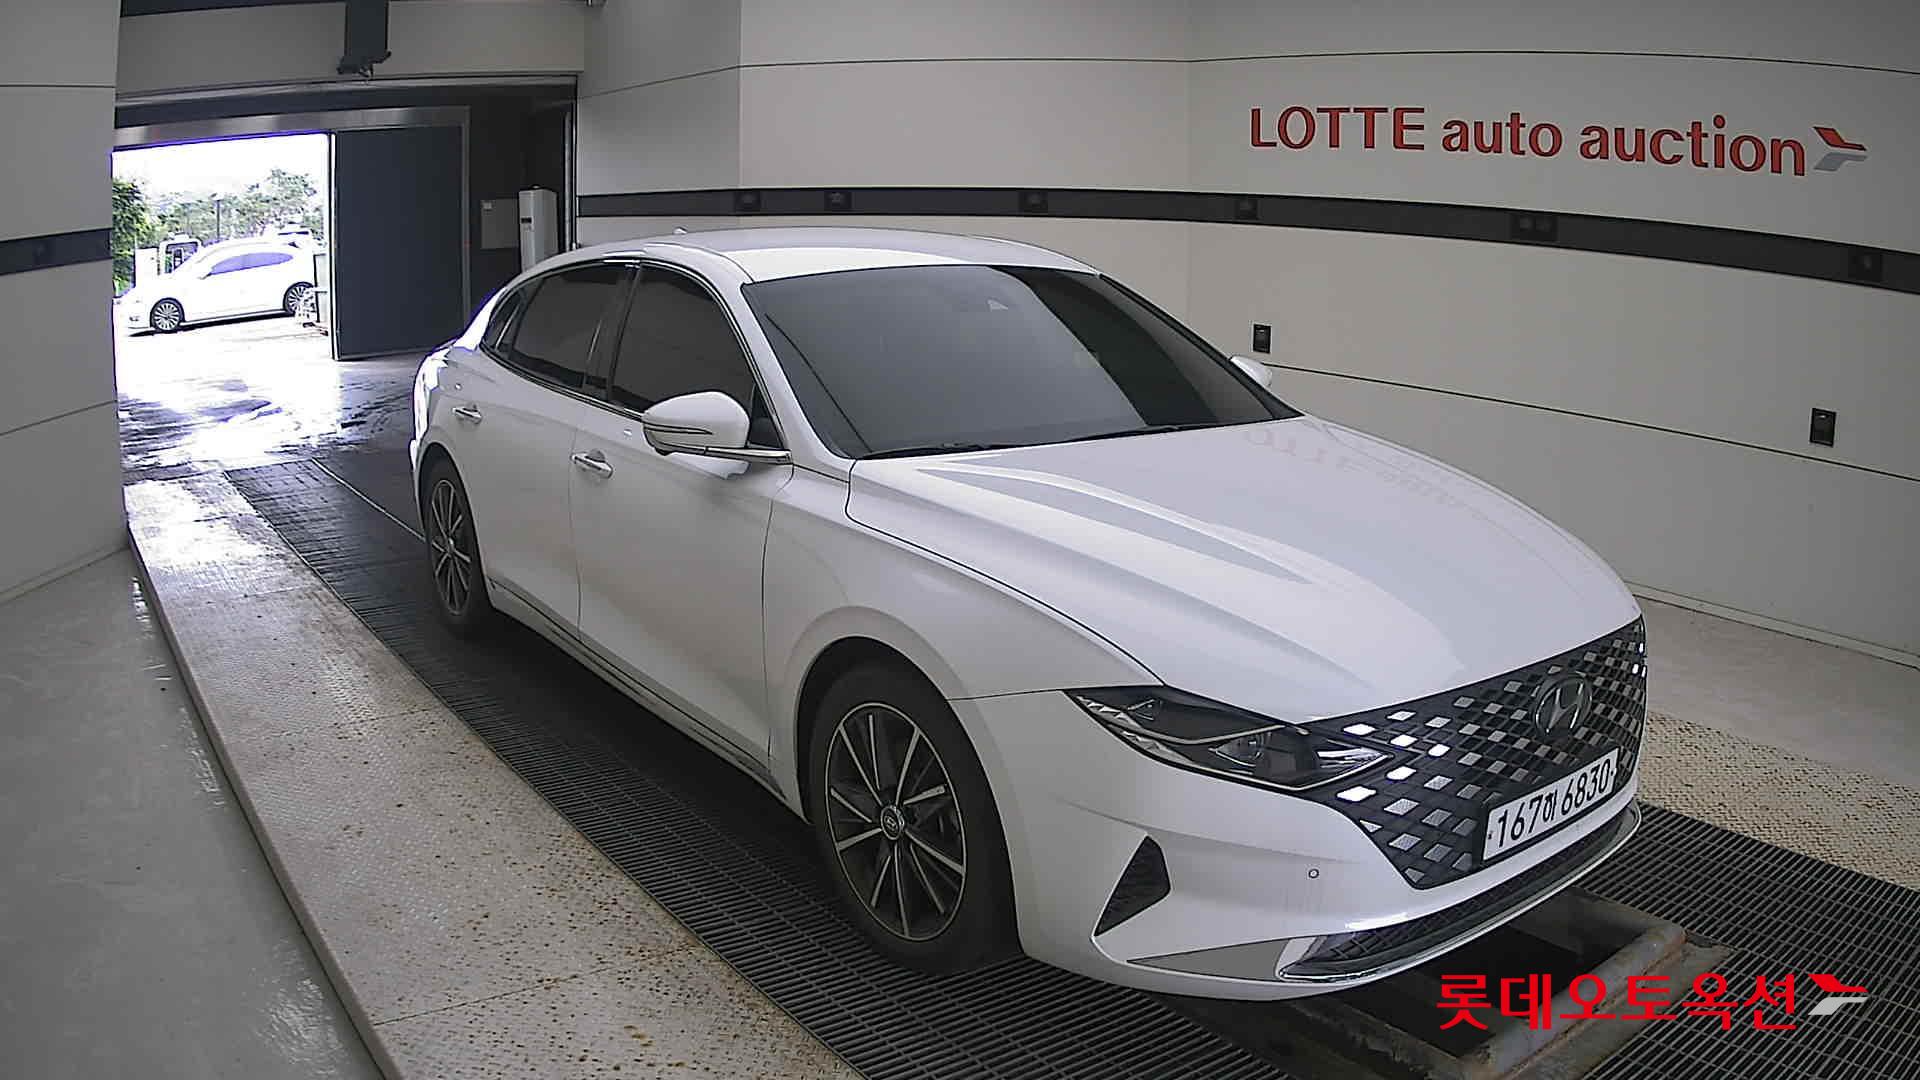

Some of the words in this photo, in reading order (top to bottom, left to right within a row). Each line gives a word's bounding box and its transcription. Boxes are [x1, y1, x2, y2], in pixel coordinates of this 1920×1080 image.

[1251, 107, 1425, 150] LOTTE
[1442, 112, 1563, 157] auto
[1580, 115, 1806, 176] auction
[1561, 758, 1611, 816] 6830
